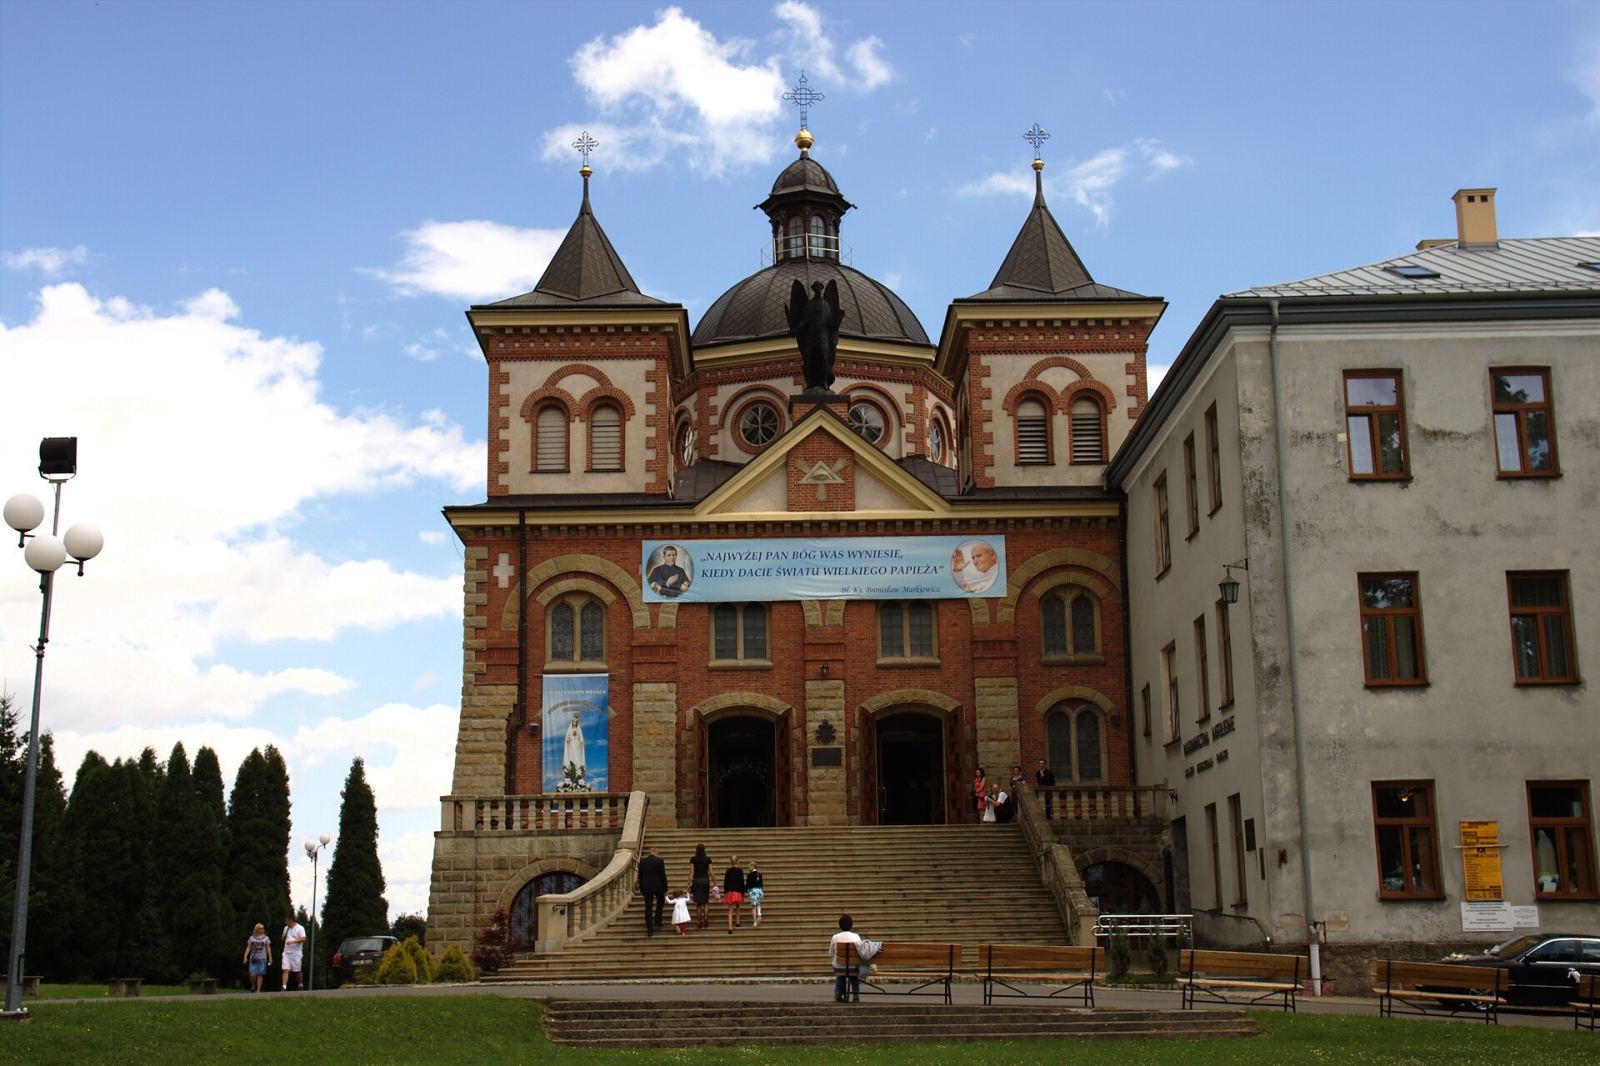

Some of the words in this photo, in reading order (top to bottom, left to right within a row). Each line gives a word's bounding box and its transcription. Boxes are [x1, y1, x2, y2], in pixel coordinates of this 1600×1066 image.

[701, 550, 761, 563] „NAJWYŻEJ
[765, 551, 788, 561] PAN
[792, 549, 816, 560] BÓG
[820, 550, 844, 559] WAS
[847, 549, 904, 560] WYNIESIE,
[701, 568, 735, 578] KIEDY
[738, 568, 772, 577] DACIE
[775, 566, 819, 577] ŚWIATU
[823, 567, 887, 576] WIELKIEGO
[890, 563, 944, 575] PAPIEŻA”
